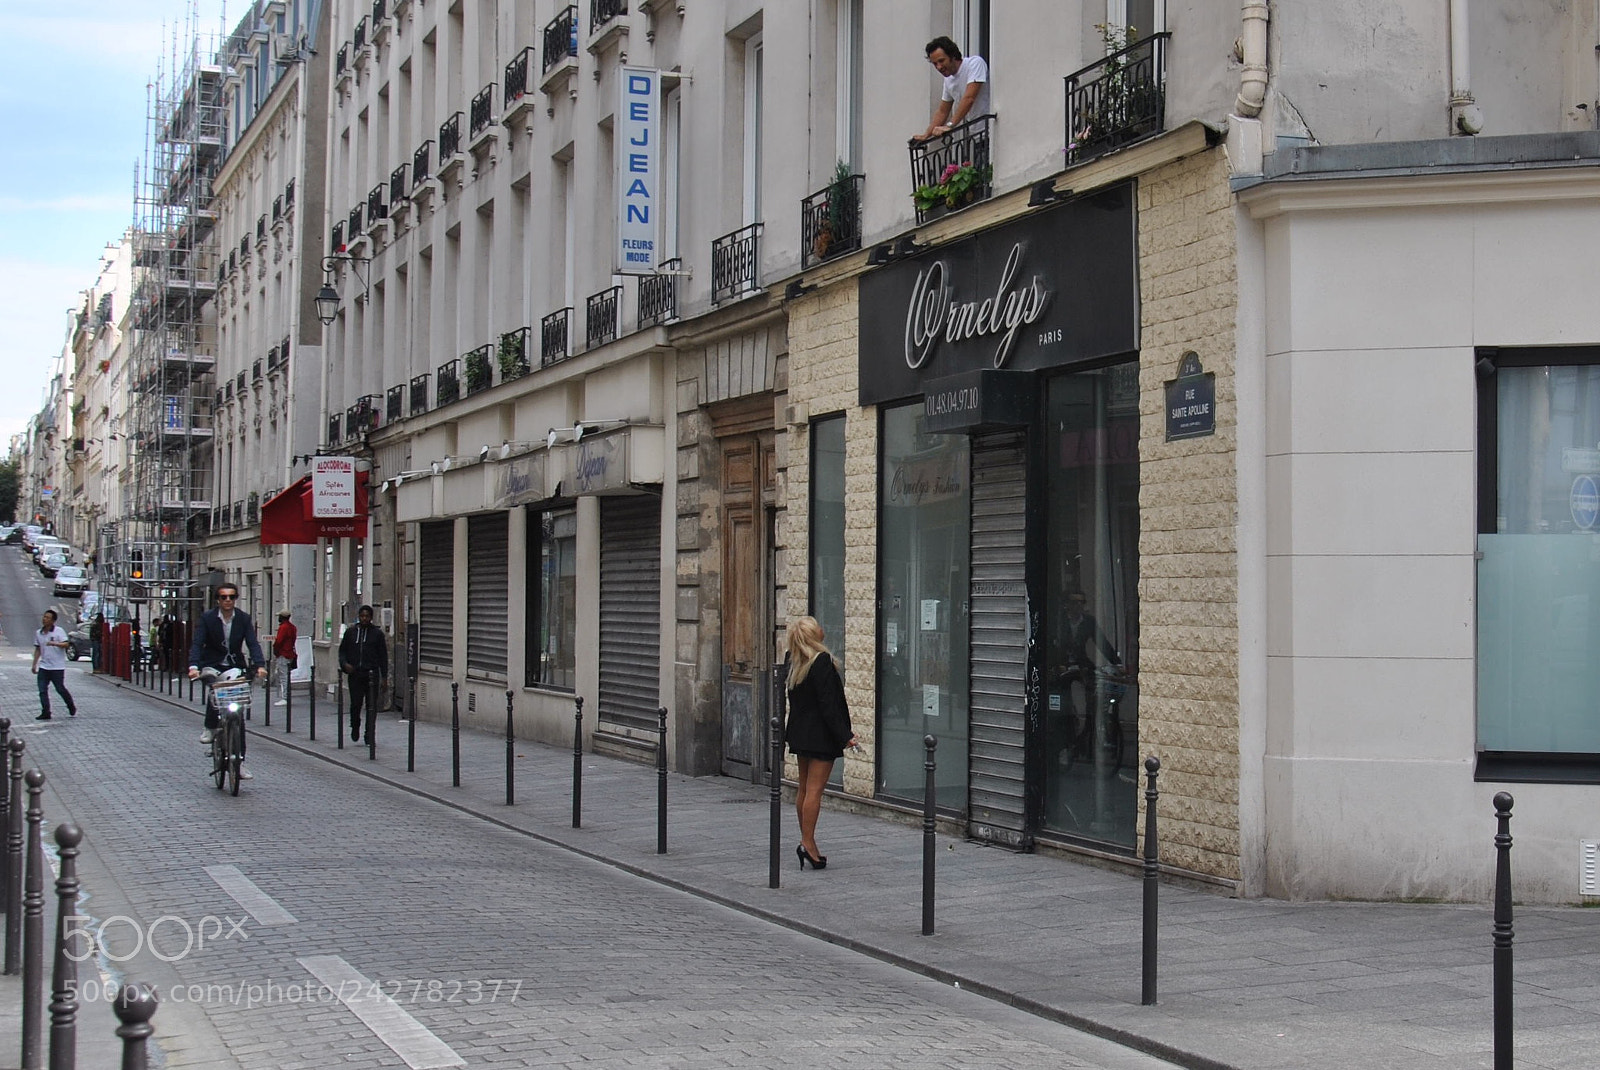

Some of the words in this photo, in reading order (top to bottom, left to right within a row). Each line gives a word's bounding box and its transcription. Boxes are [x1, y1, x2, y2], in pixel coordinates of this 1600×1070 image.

[627, 76, 651, 223] DEJEAN
[623, 240, 653, 250] FLEURS
[626, 253, 650, 262] MODE
[1038, 329, 1062, 346] PARIS
[926, 386, 979, 417] 01.48.04.97.10
[1185, 389, 1195, 400] RUE
